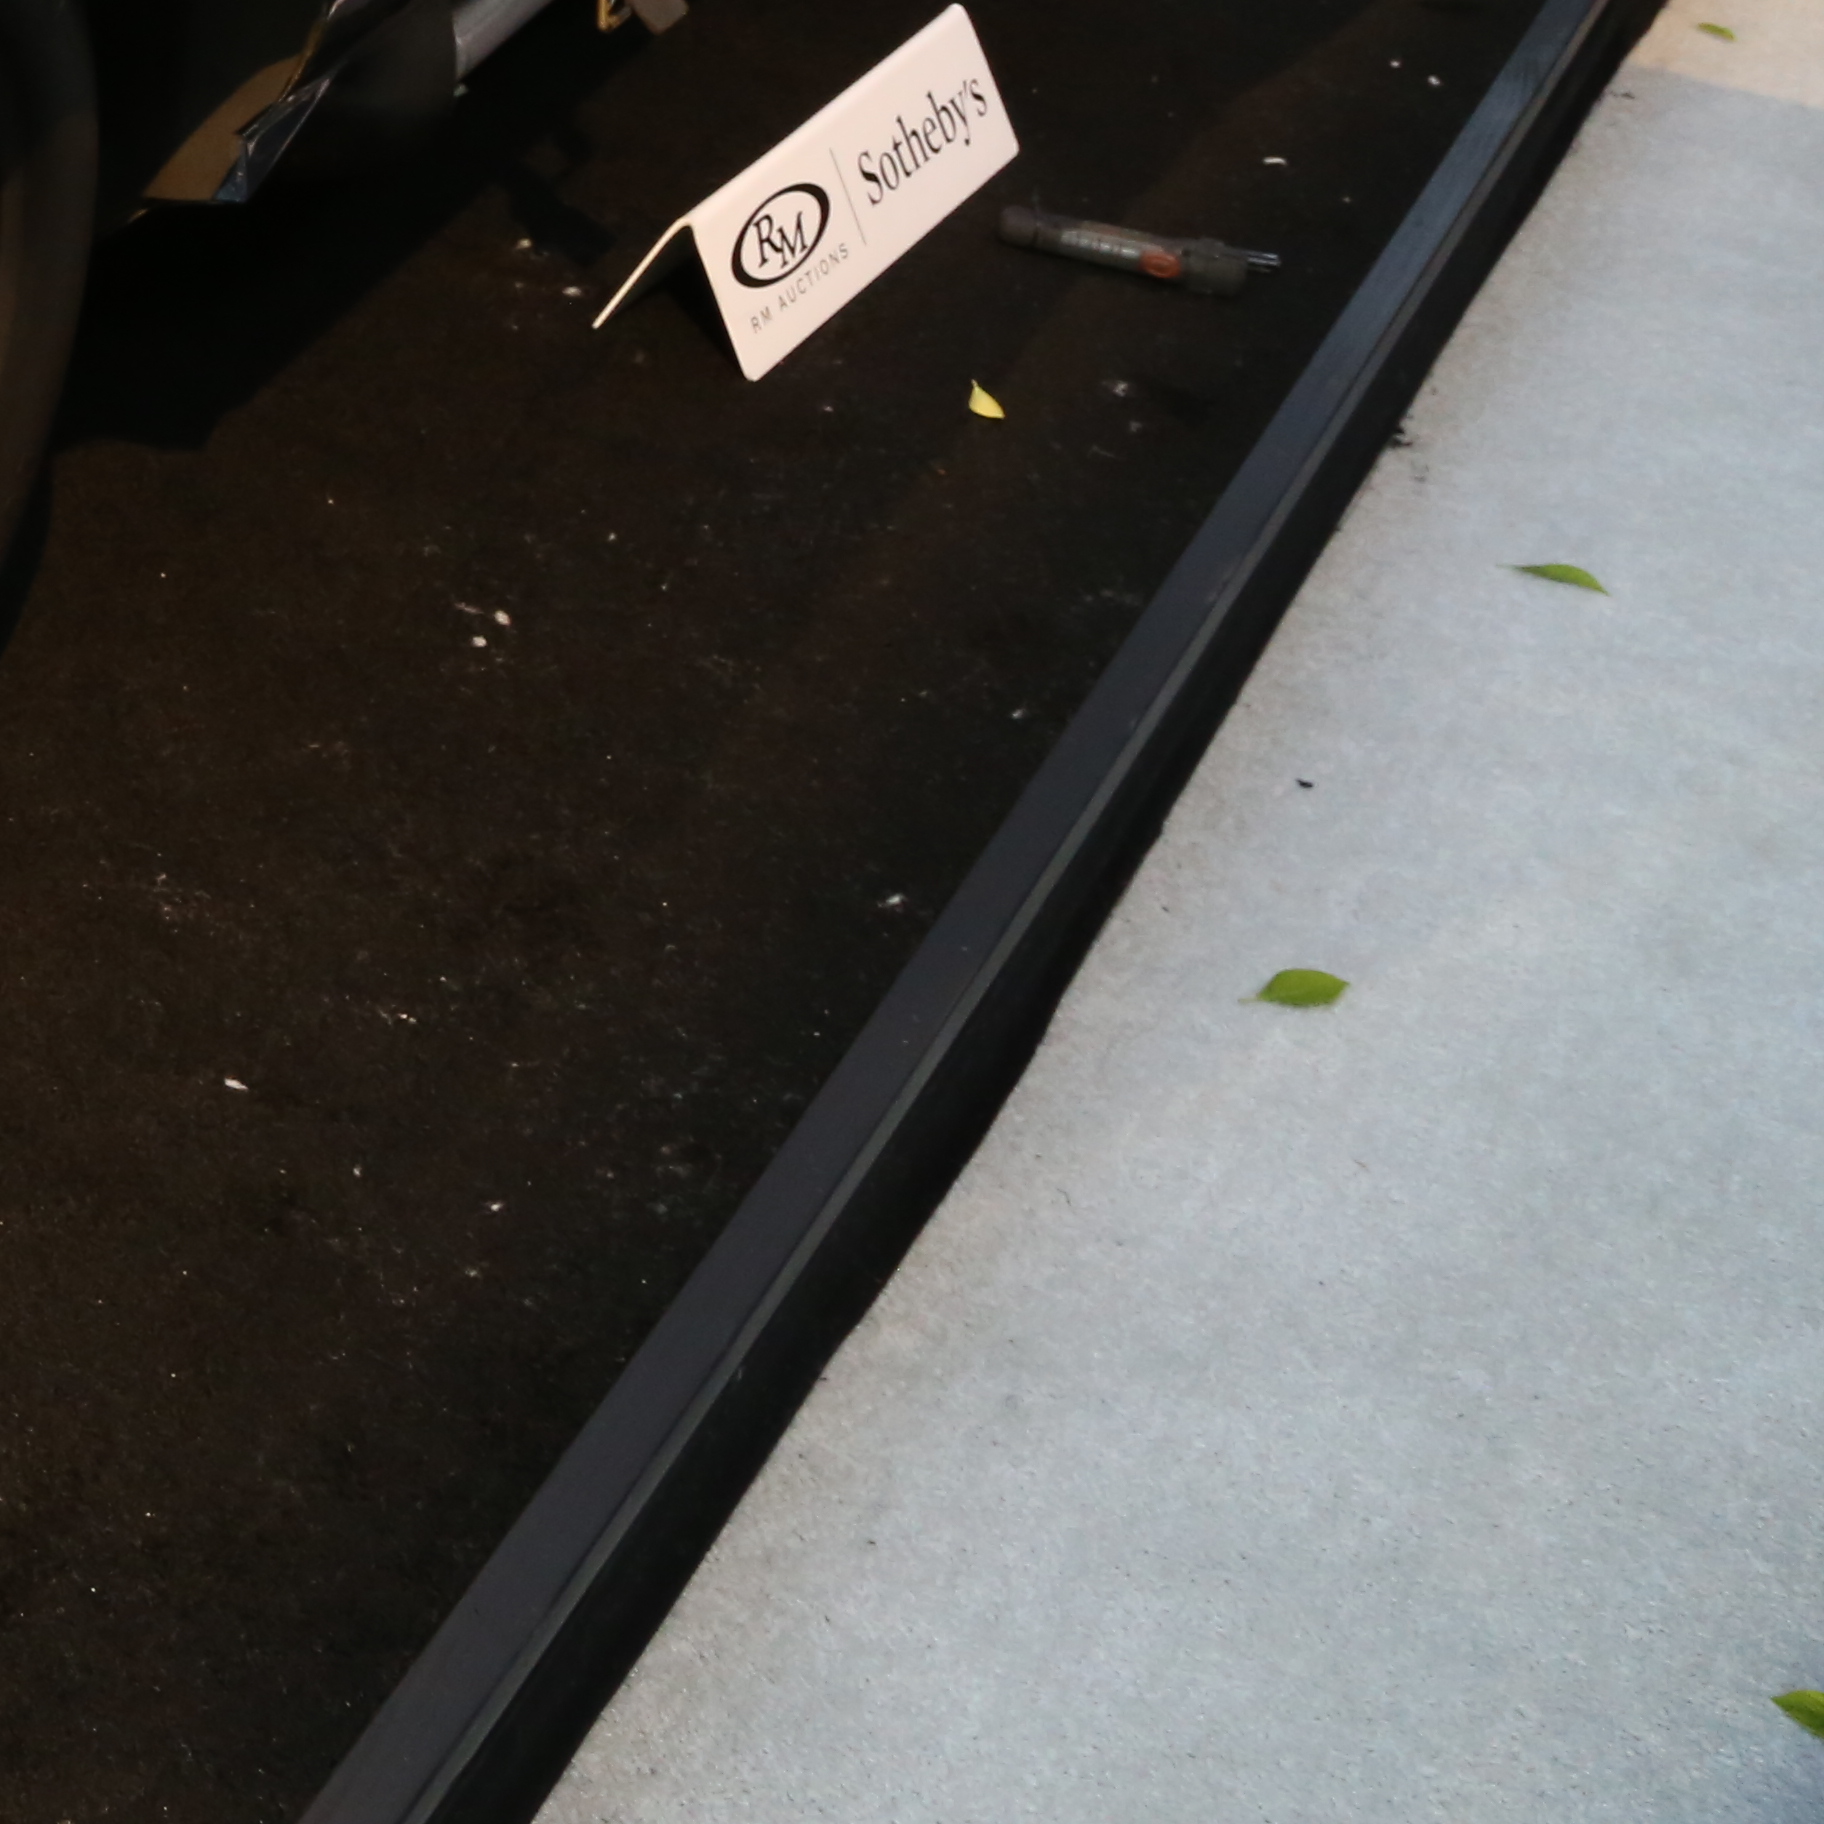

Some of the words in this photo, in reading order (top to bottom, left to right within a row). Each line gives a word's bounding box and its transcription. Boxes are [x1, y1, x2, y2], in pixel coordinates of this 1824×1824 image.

[857, 77, 988, 207] Sotheby's
[751, 306, 773, 333] RM
[778, 242, 849, 311] AUCTIONS
